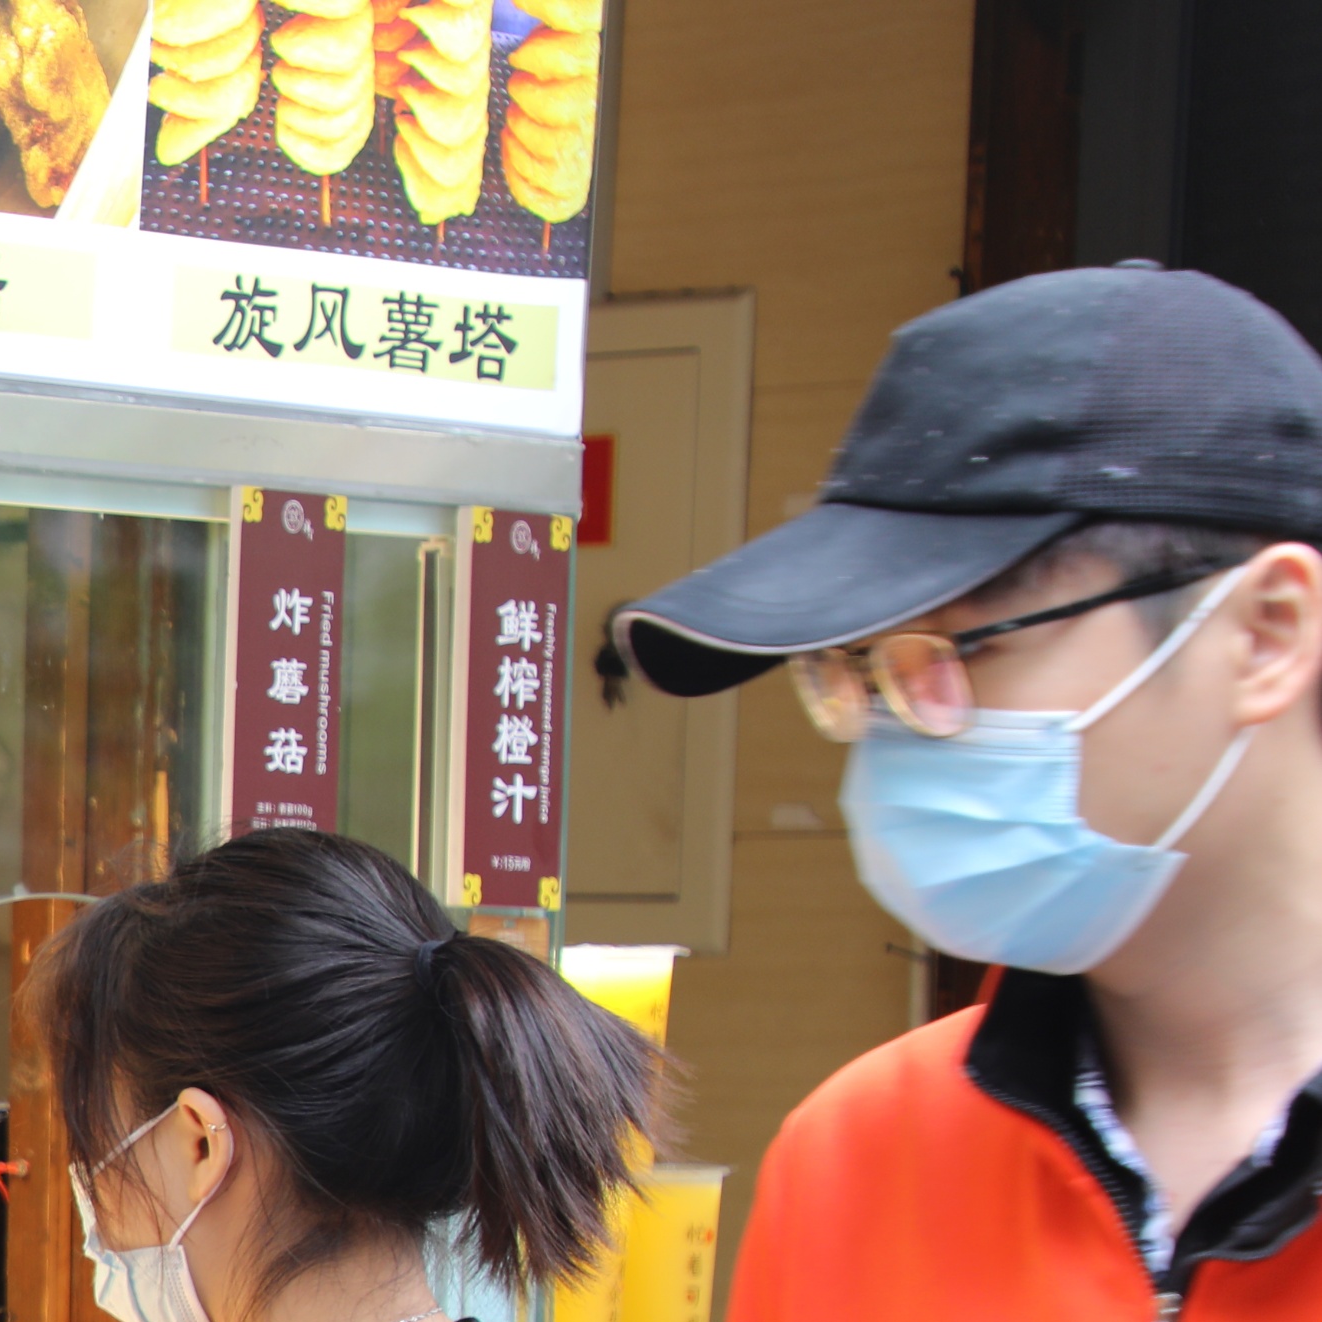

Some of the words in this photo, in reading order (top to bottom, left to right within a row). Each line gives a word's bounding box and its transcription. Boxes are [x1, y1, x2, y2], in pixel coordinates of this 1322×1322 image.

[212, 274, 519, 382] 旋风薯塔
[320, 591, 335, 647] Fried
[542, 603, 557, 660] Freshly
[264, 587, 313, 775] 炸蘑菇
[315, 649, 332, 776] mushrooms
[491, 599, 542, 825] 鲜榨橙汁
[538, 785, 551, 824] juice
